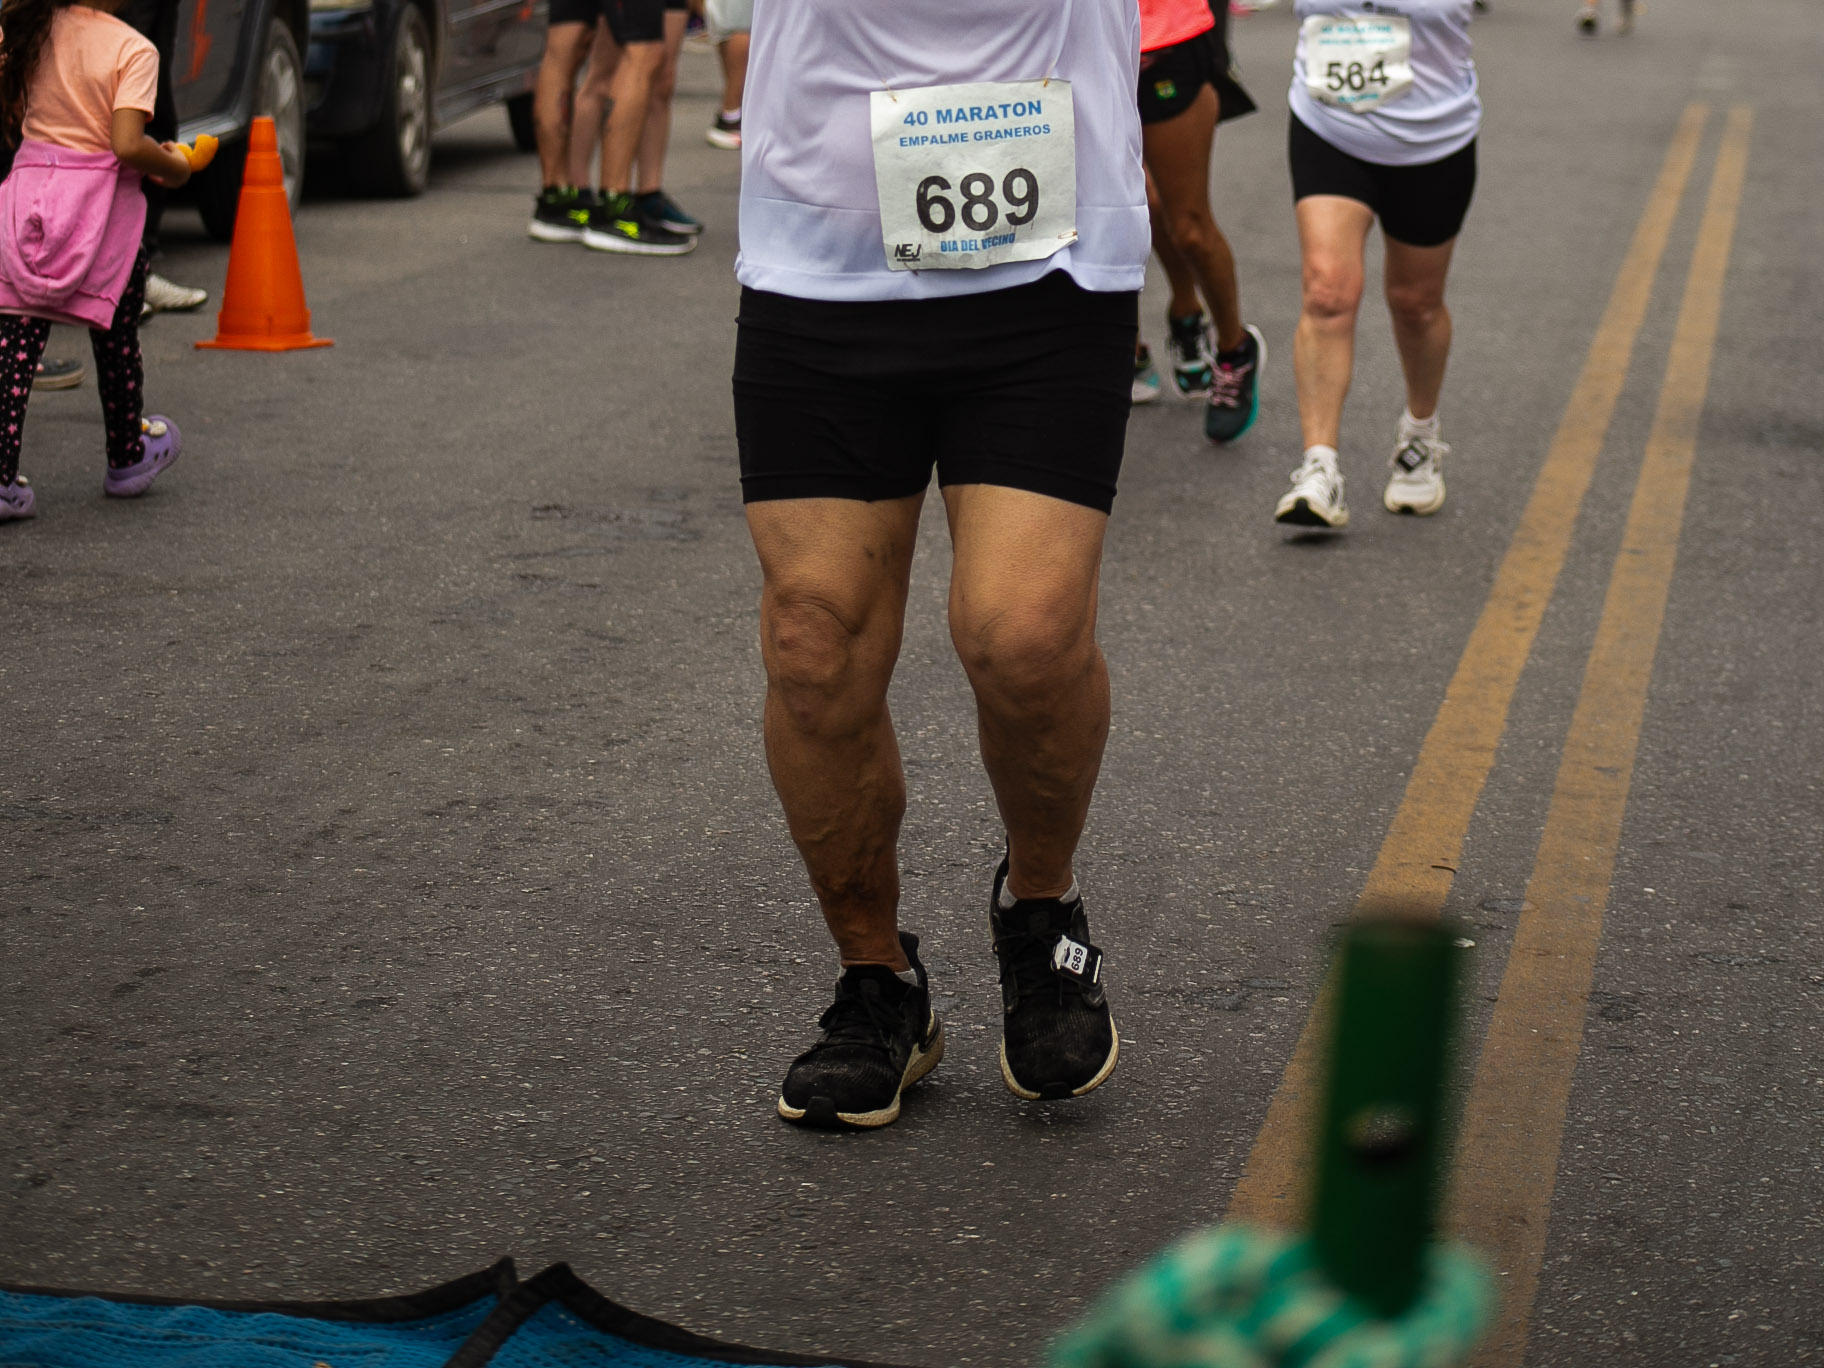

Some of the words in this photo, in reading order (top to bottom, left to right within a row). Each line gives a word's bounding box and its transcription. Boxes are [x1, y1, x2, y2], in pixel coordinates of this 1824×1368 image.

[1326, 58, 1389, 91] 564
[903, 110, 928, 126] 40
[936, 100, 1042, 125] MARATON
[899, 131, 969, 147] EMPALME
[973, 124, 1051, 142] GRANEROS
[916, 167, 1040, 234] 689
[894, 243, 922, 258] NEJ
[940, 241, 958, 253] DIA
[961, 238, 979, 252] DEL
[982, 233, 1016, 251] VECINO
[1071, 947, 1084, 971] 689
